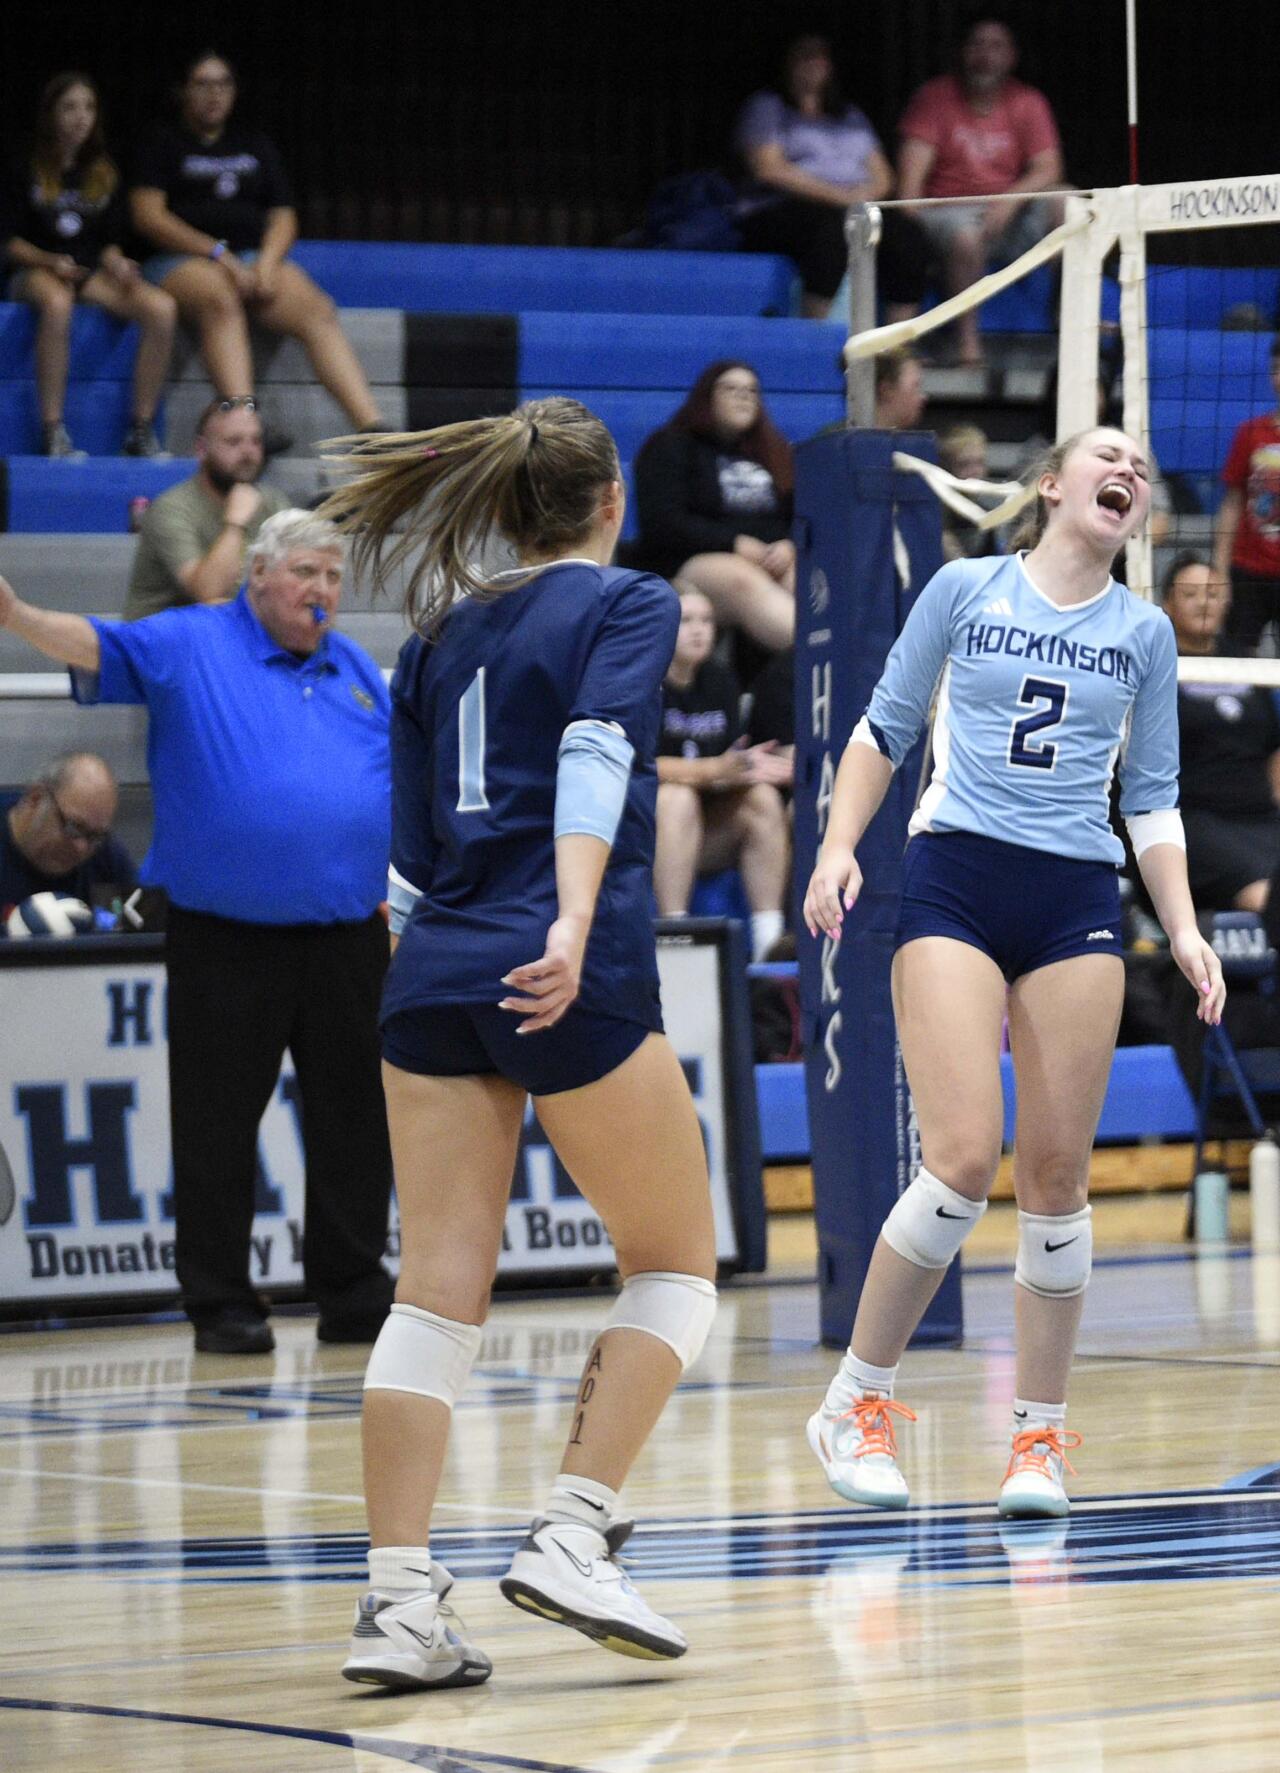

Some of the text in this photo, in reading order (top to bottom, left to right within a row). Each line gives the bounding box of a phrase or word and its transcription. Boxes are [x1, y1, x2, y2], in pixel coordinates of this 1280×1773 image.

[1170, 183, 1279, 219] HOCKINSON
[966, 622, 1132, 684] HOCKINSON
[456, 666, 491, 812] 1
[1006, 673, 1070, 773] 2
[811, 660, 843, 1092] HAKS
[27, 1232, 177, 1278] Donate
